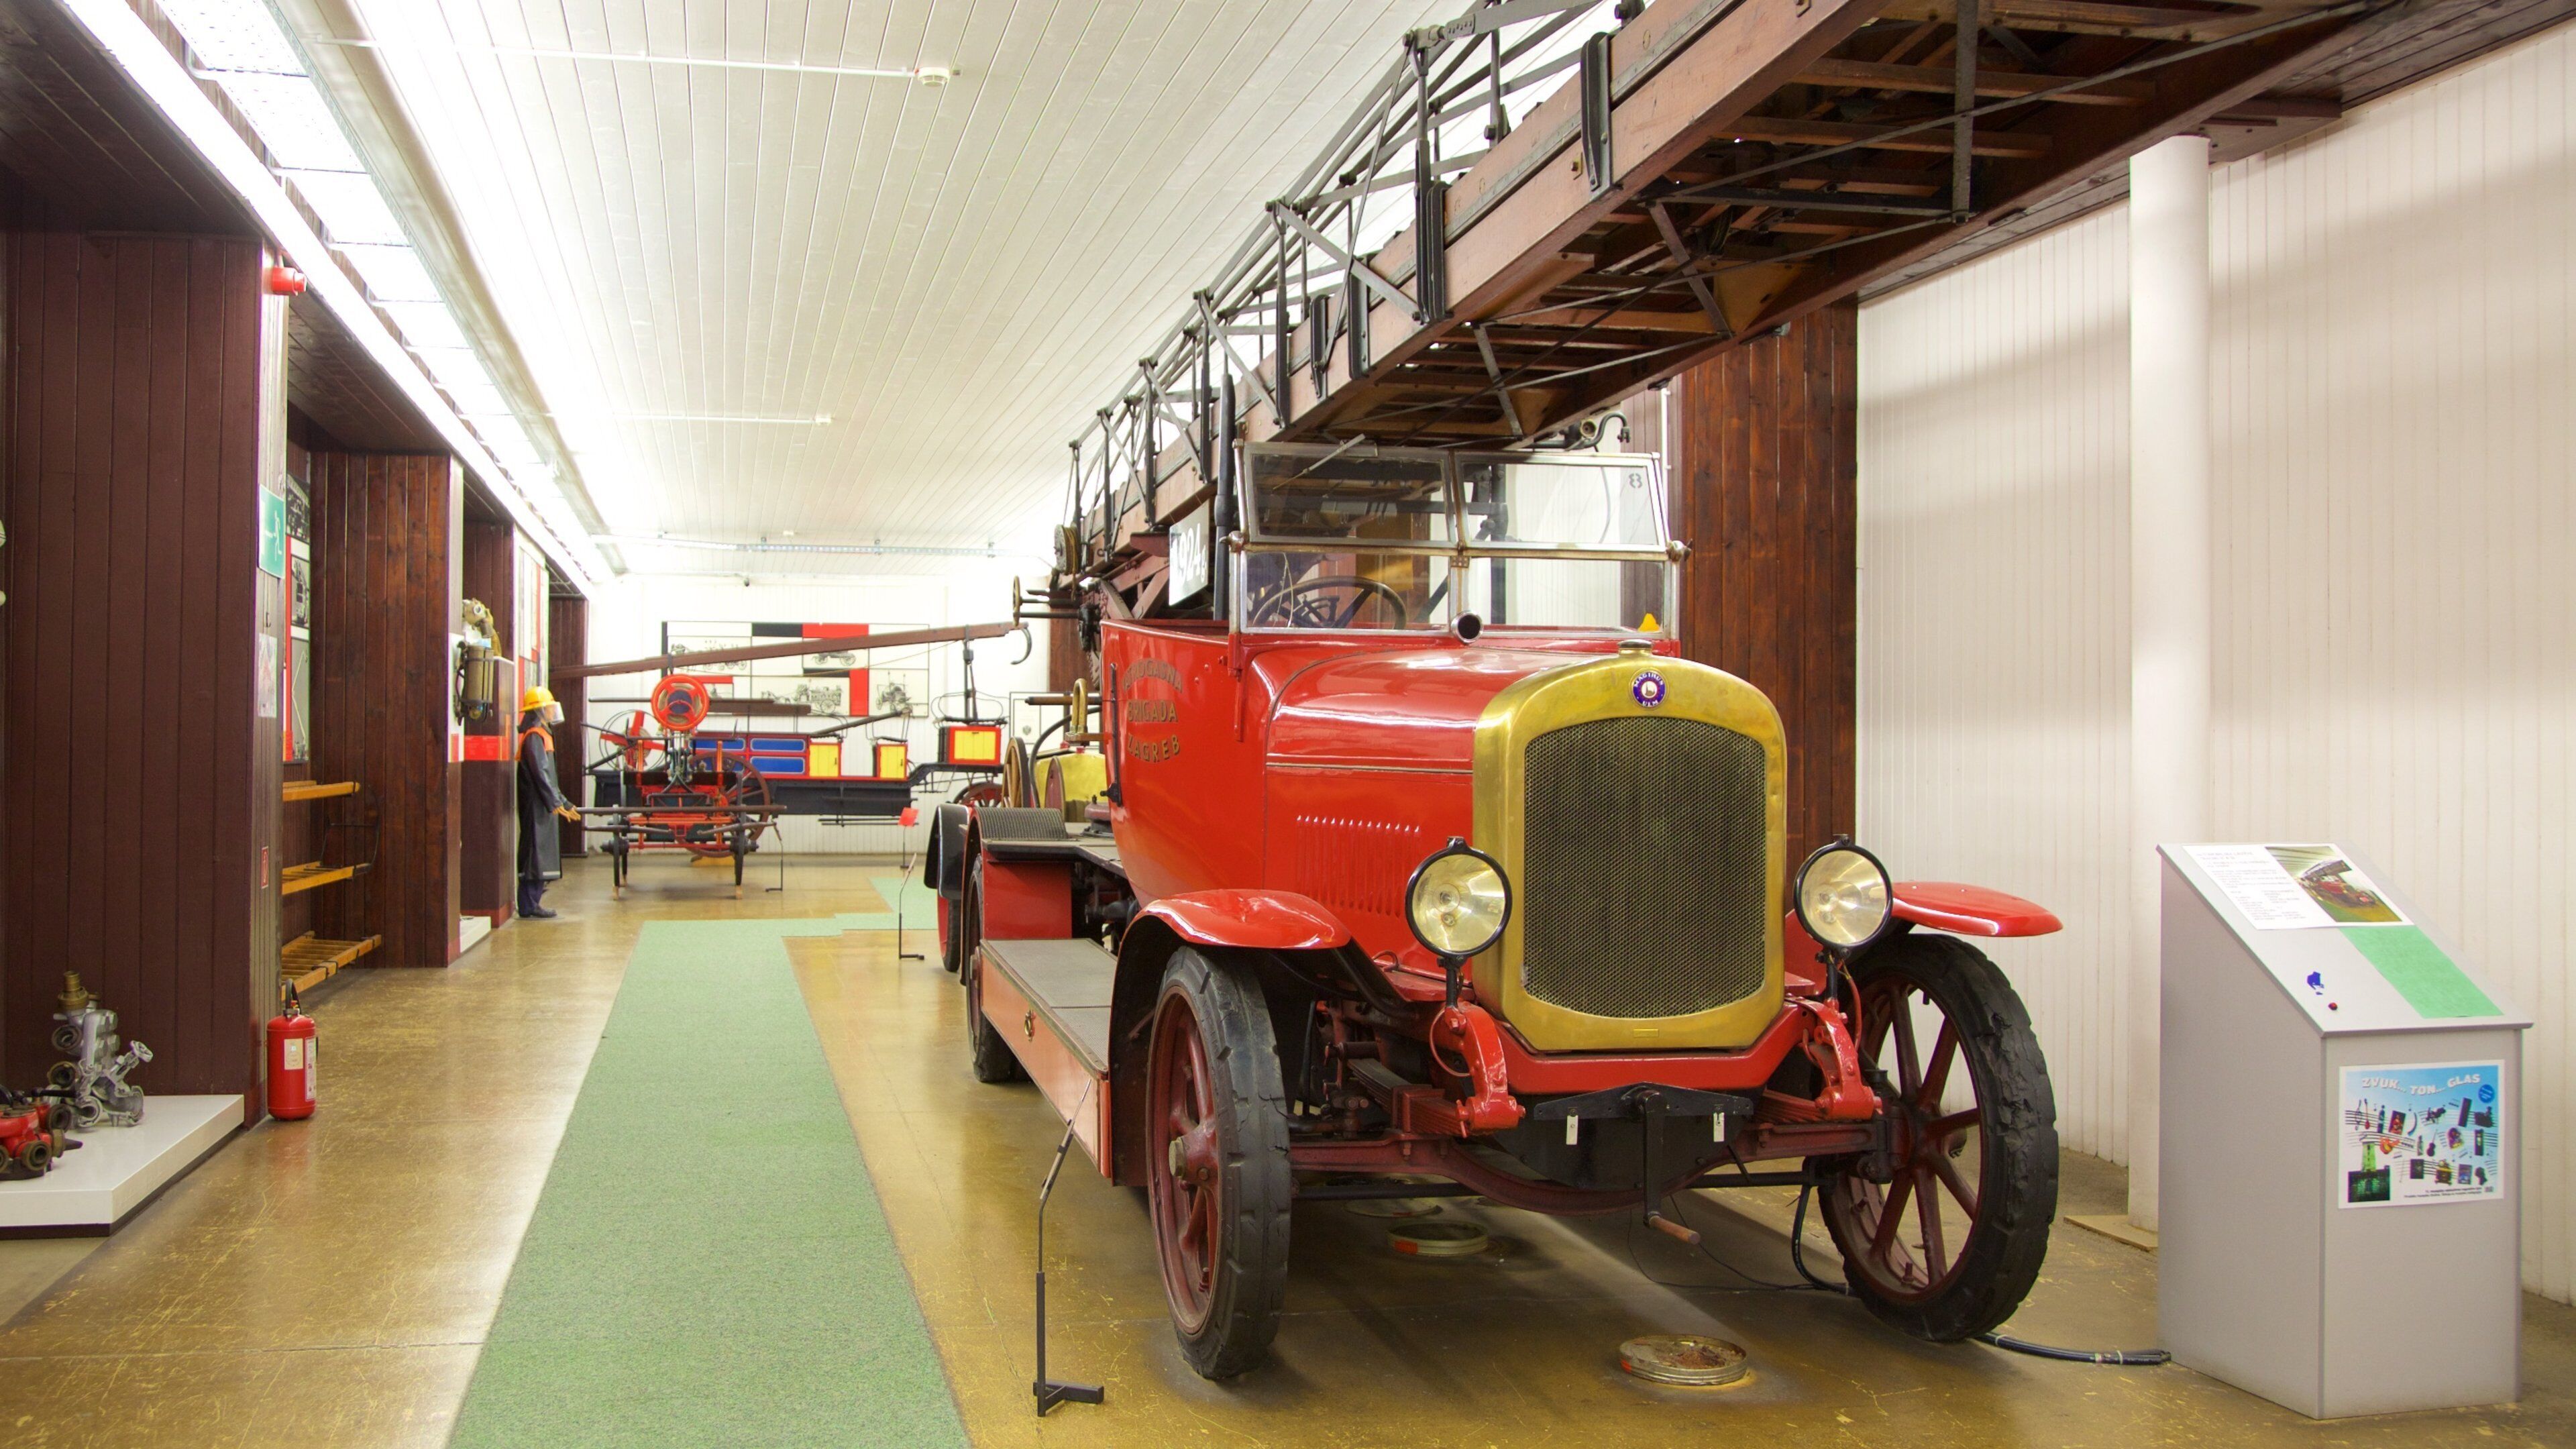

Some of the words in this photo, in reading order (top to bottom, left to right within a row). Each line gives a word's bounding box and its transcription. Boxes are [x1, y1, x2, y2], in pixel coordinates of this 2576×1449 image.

[1634, 672, 1664, 687] MAGIRUS
[1127, 700, 1178, 722] BRIGADA
[1128, 733, 1181, 763] ZAGREB
[2447, 1073, 2481, 1087] GLAS
